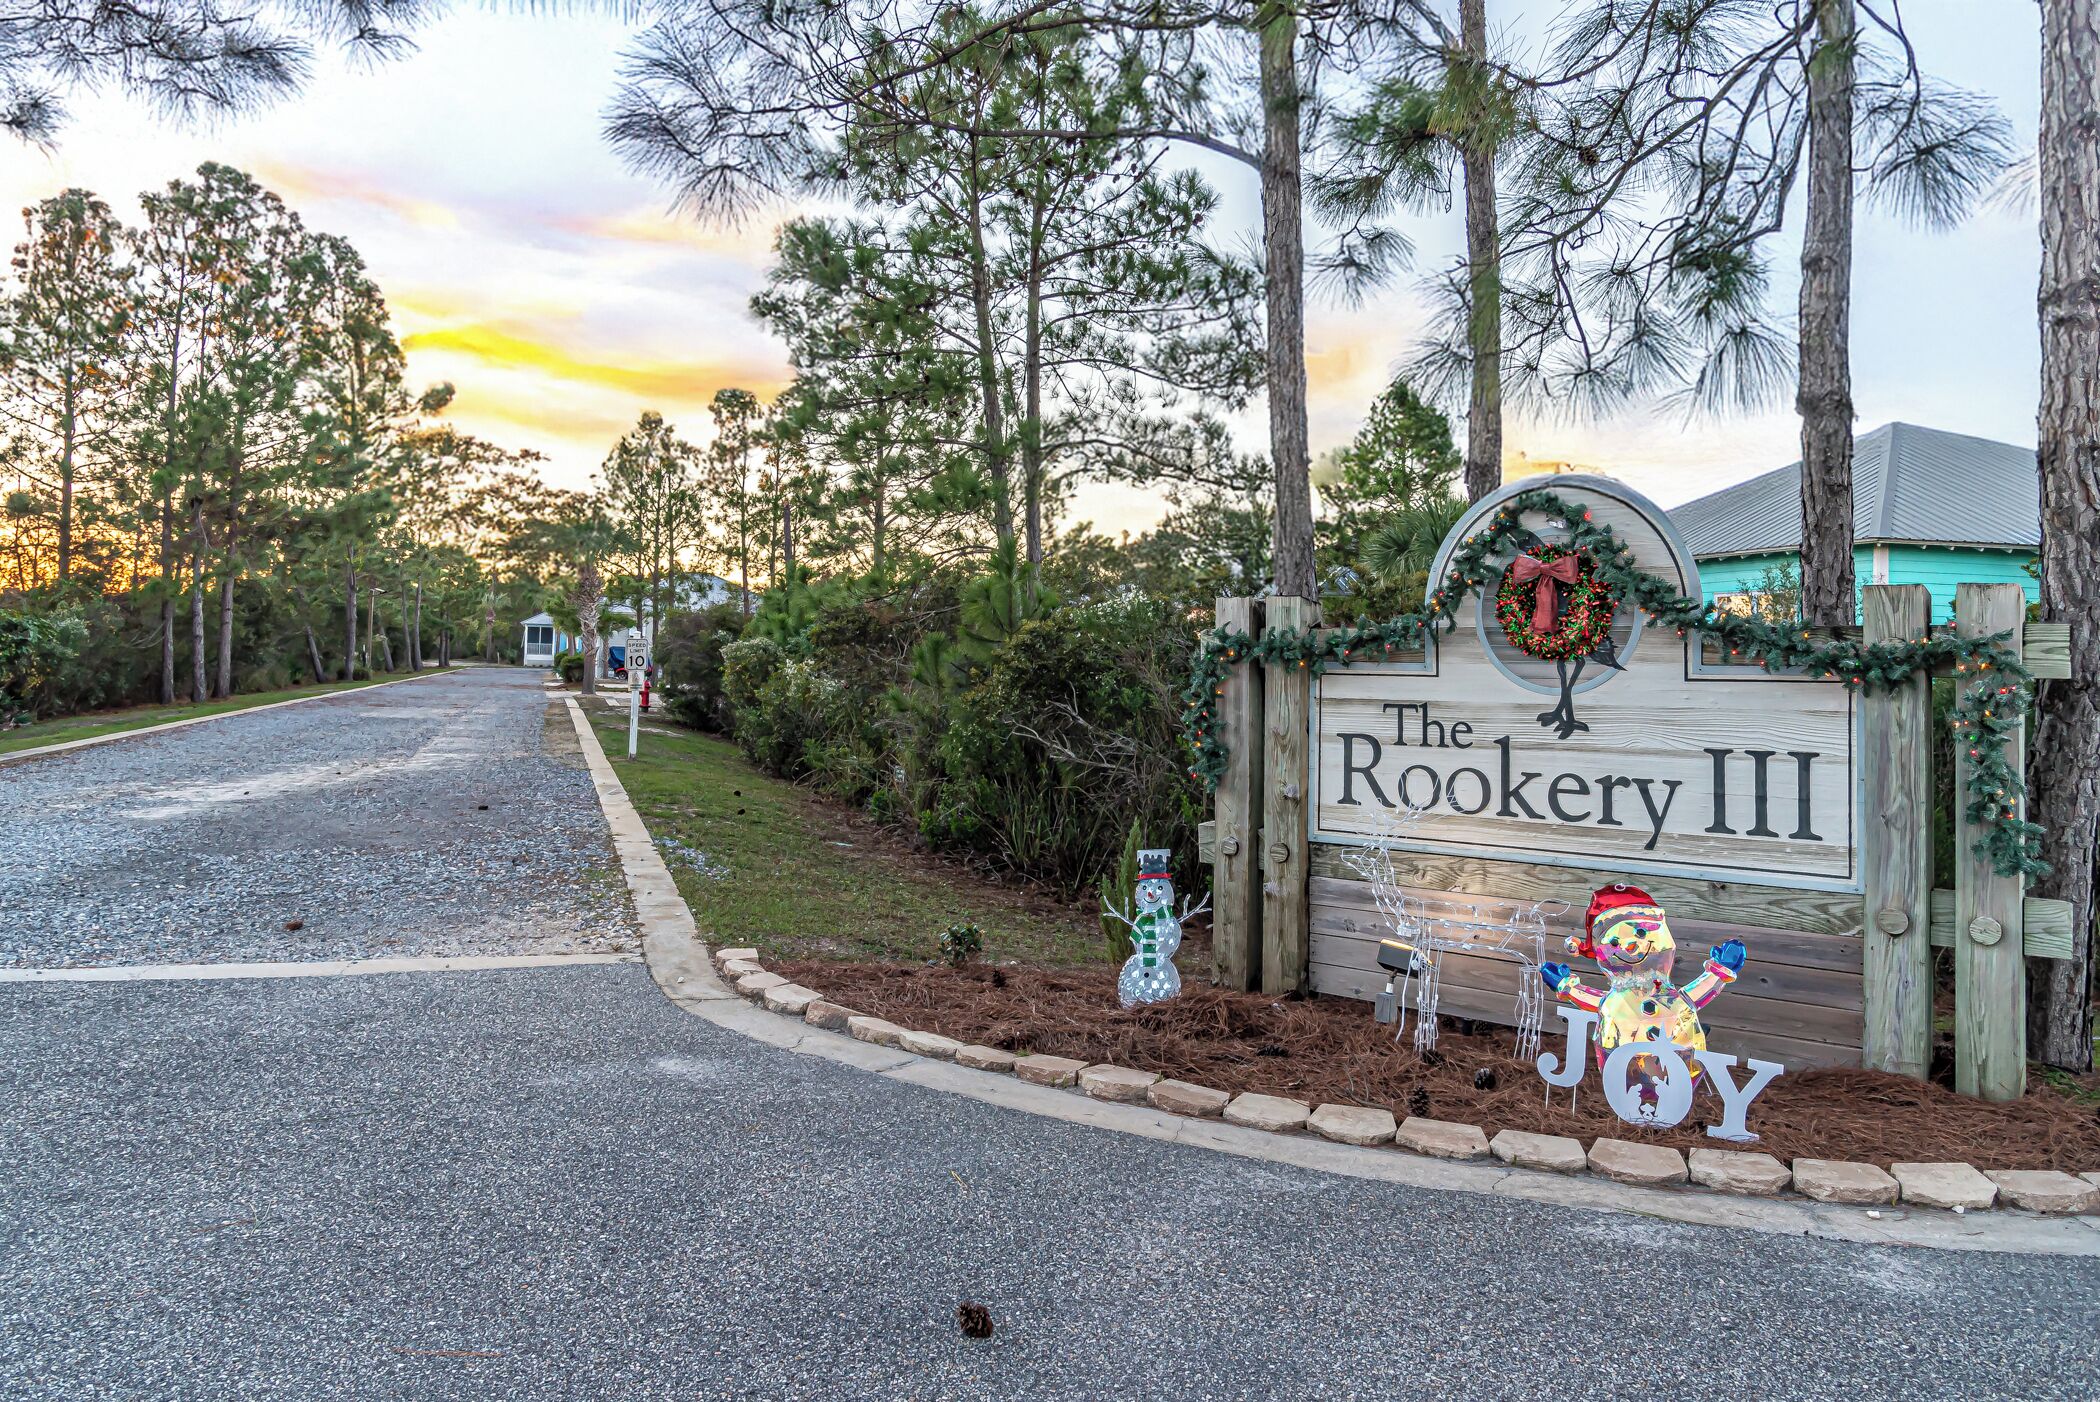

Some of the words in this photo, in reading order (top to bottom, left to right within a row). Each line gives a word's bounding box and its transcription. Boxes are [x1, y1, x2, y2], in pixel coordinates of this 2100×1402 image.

[629, 655, 645, 667] 10
[1383, 702, 1474, 749] The
[1336, 732, 1682, 850] Rookery
[1703, 747, 1823, 841] III
[1537, 1006, 1784, 1142] JOY
